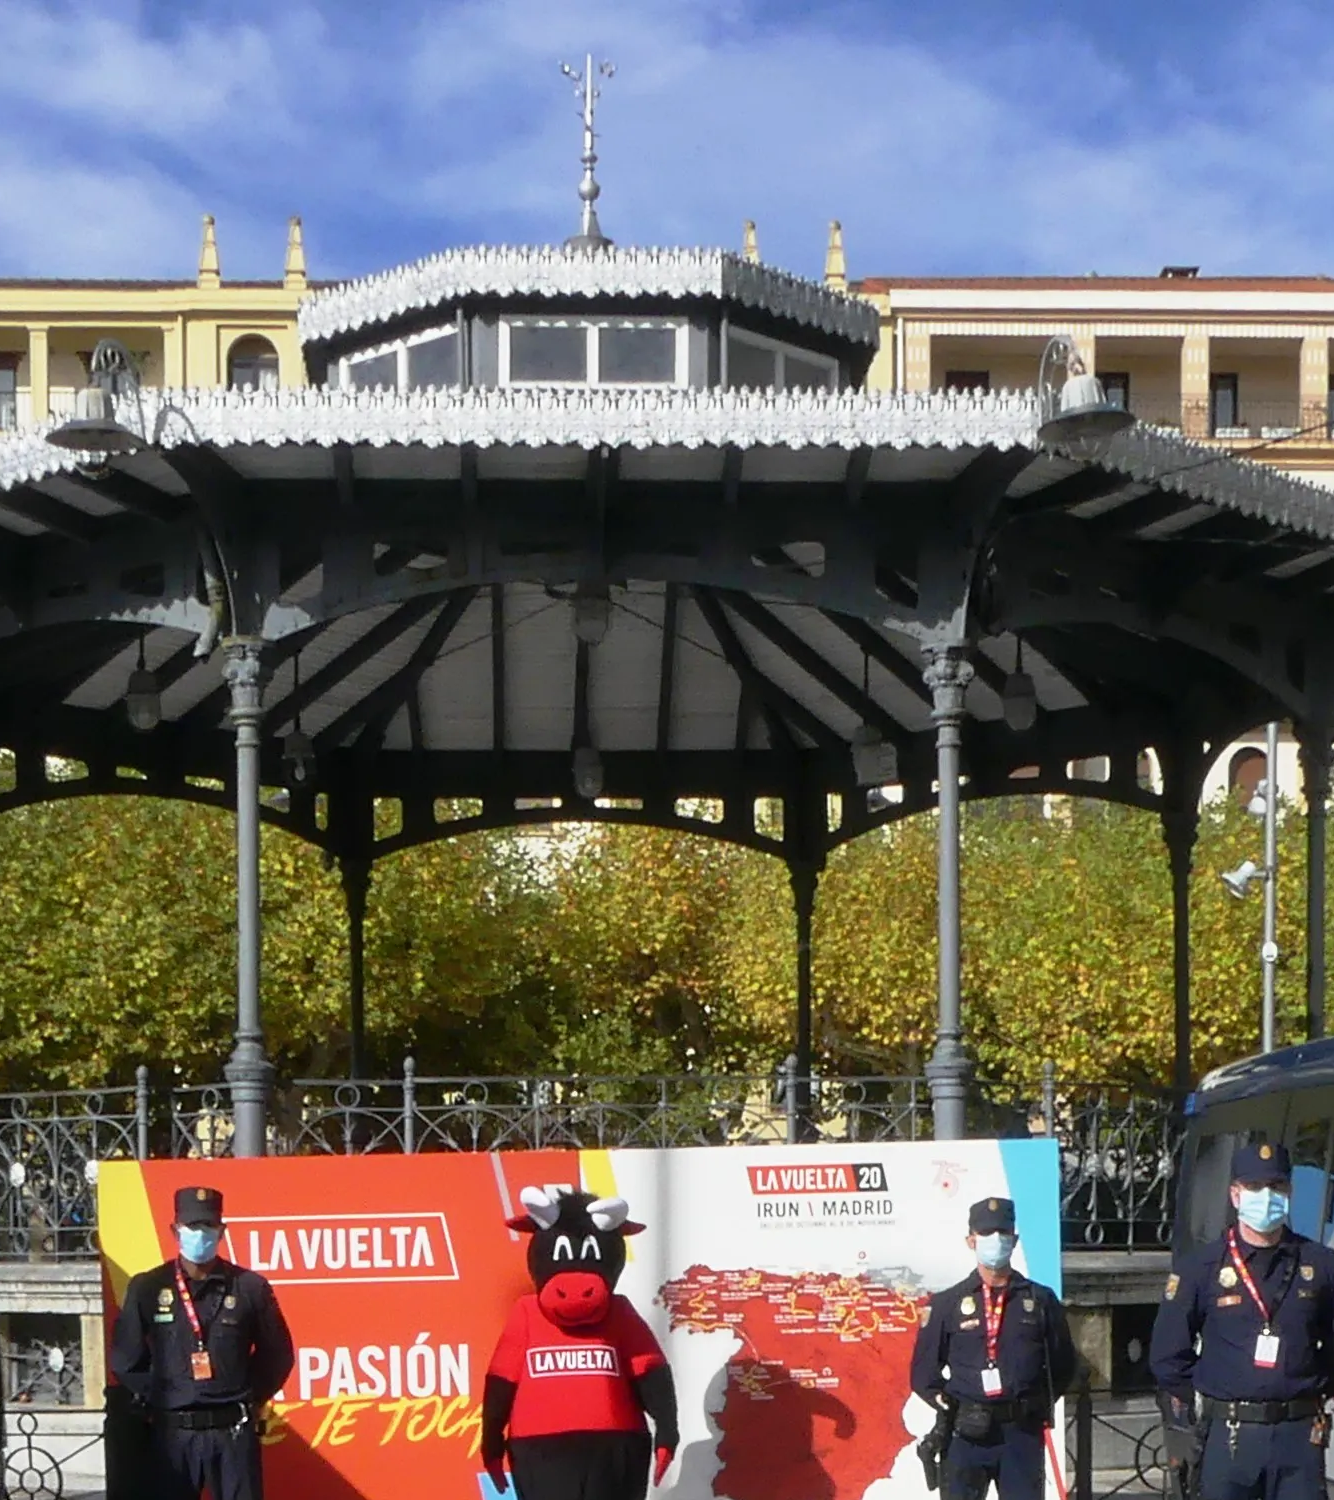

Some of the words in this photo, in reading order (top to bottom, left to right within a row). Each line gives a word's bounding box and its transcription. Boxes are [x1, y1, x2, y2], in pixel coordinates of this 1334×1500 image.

[756, 1168, 779, 1191] LA
[780, 1168, 848, 1190] VUELTA
[859, 1166, 881, 1189] 20
[757, 1202, 799, 1218] IRUN
[823, 1200, 893, 1216] MADRID
[249, 1230, 293, 1271] LA
[297, 1226, 435, 1269] VUELTA
[299, 1332, 470, 1400] PASIÓN
[536, 1353, 555, 1371] LA
[555, 1351, 613, 1370] VUELTA
[309, 1395, 377, 1449] TE
